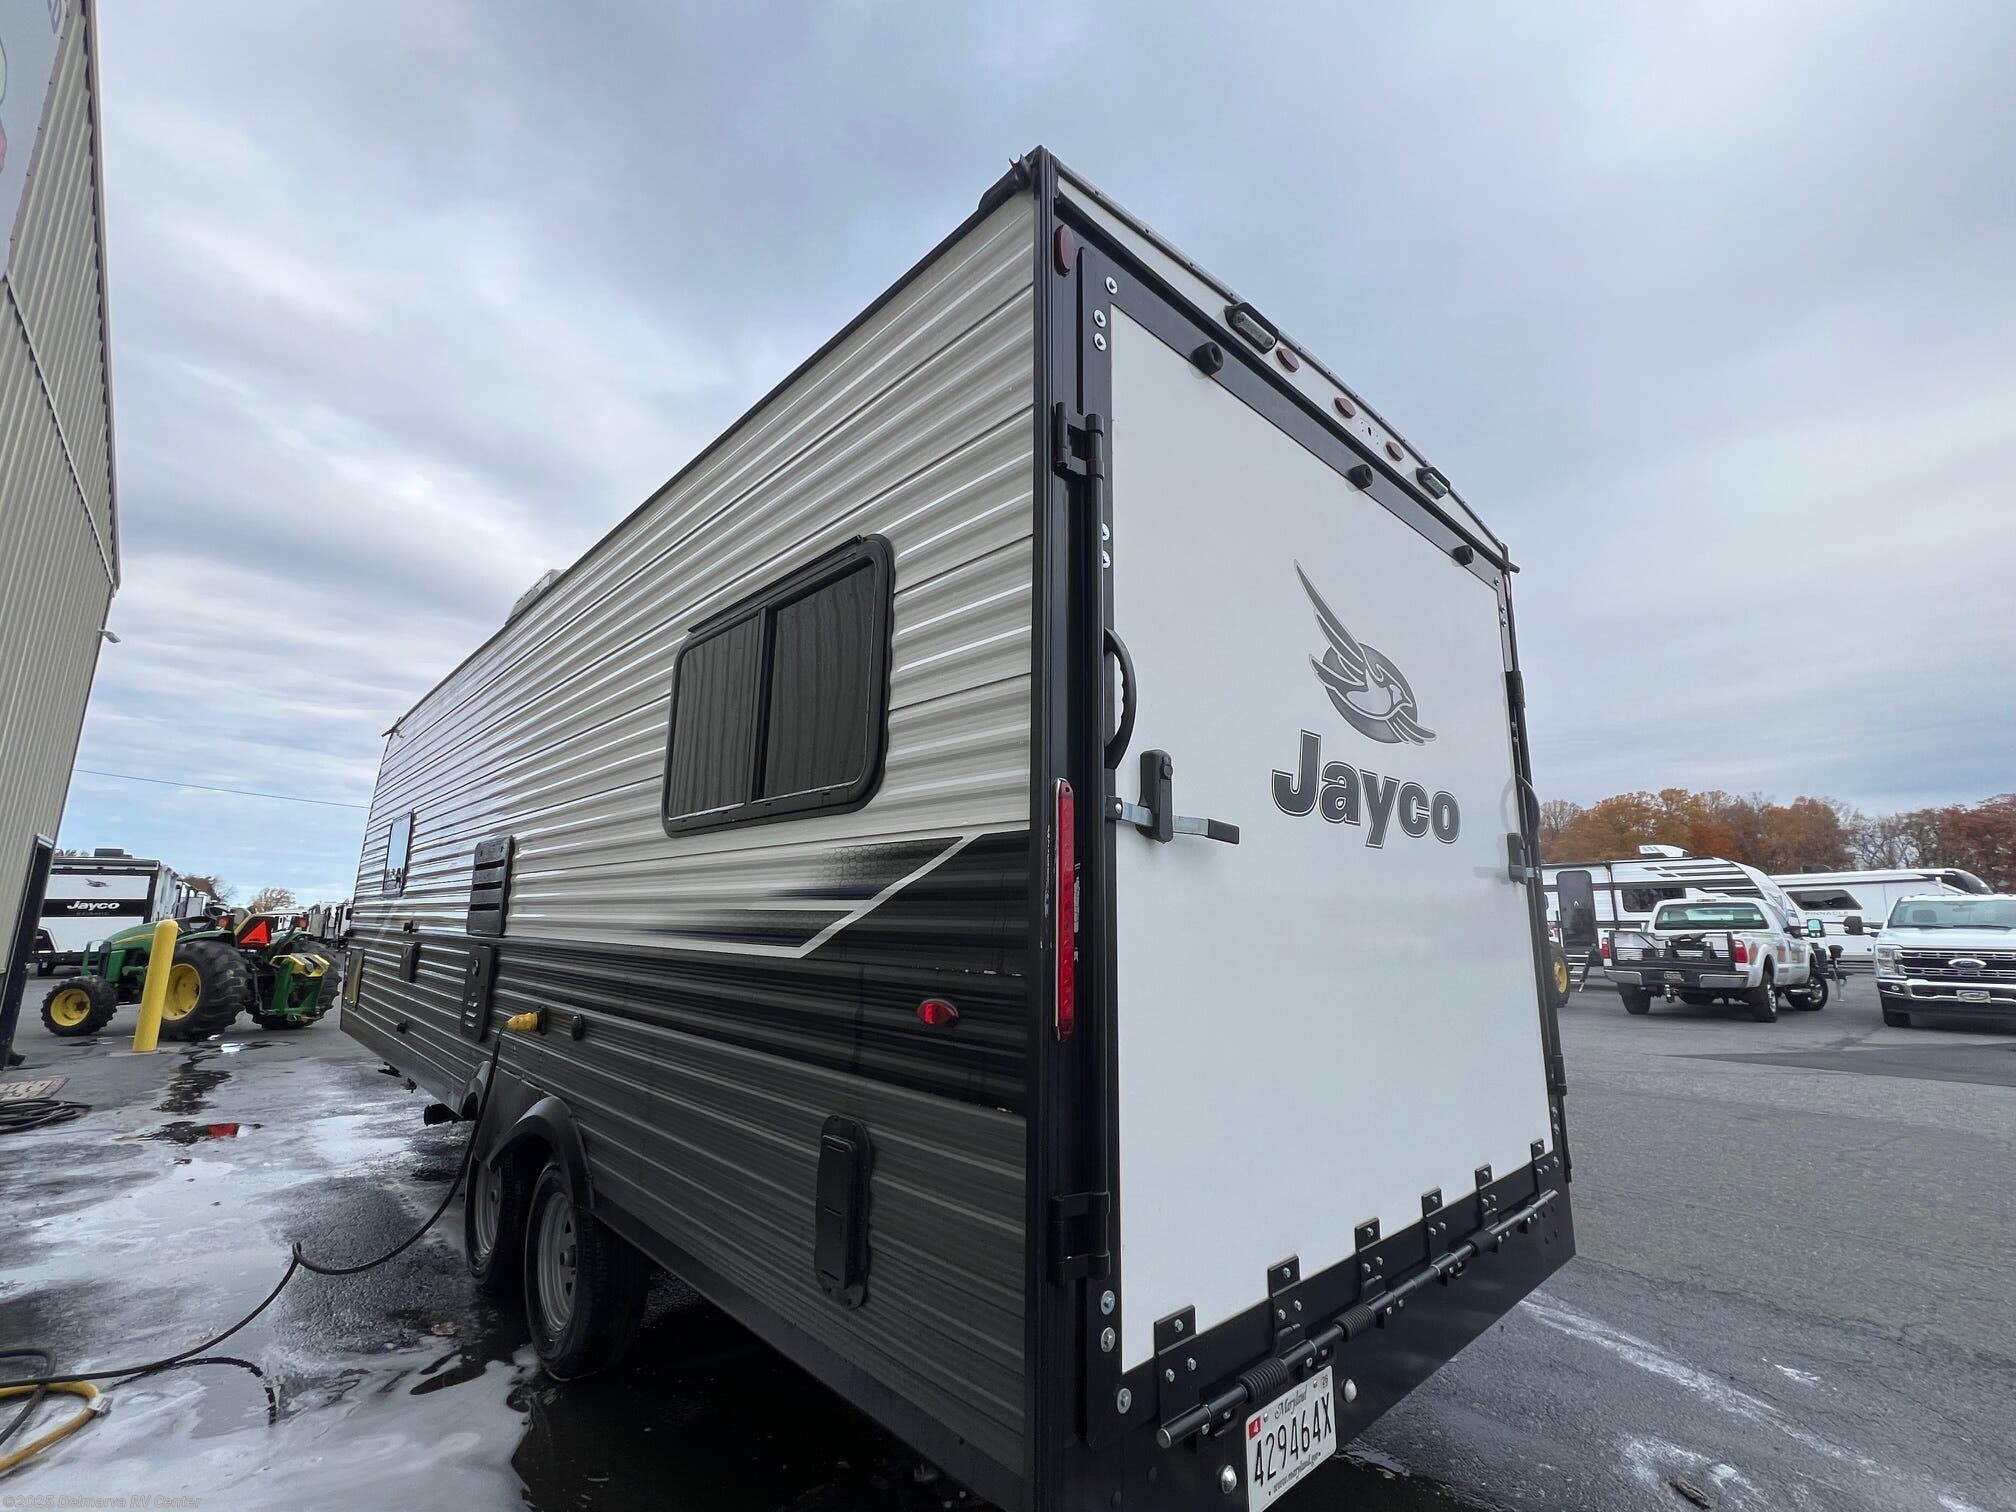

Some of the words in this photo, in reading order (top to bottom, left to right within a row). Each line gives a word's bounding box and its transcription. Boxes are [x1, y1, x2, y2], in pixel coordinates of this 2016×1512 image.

[1271, 729, 1461, 850] Jayco
[67, 901, 120, 911] Jayco
[1274, 1384, 1308, 1420] Maryland
[1253, 1420, 1259, 1433] 4
[1254, 1391, 1332, 1488] 429464X
